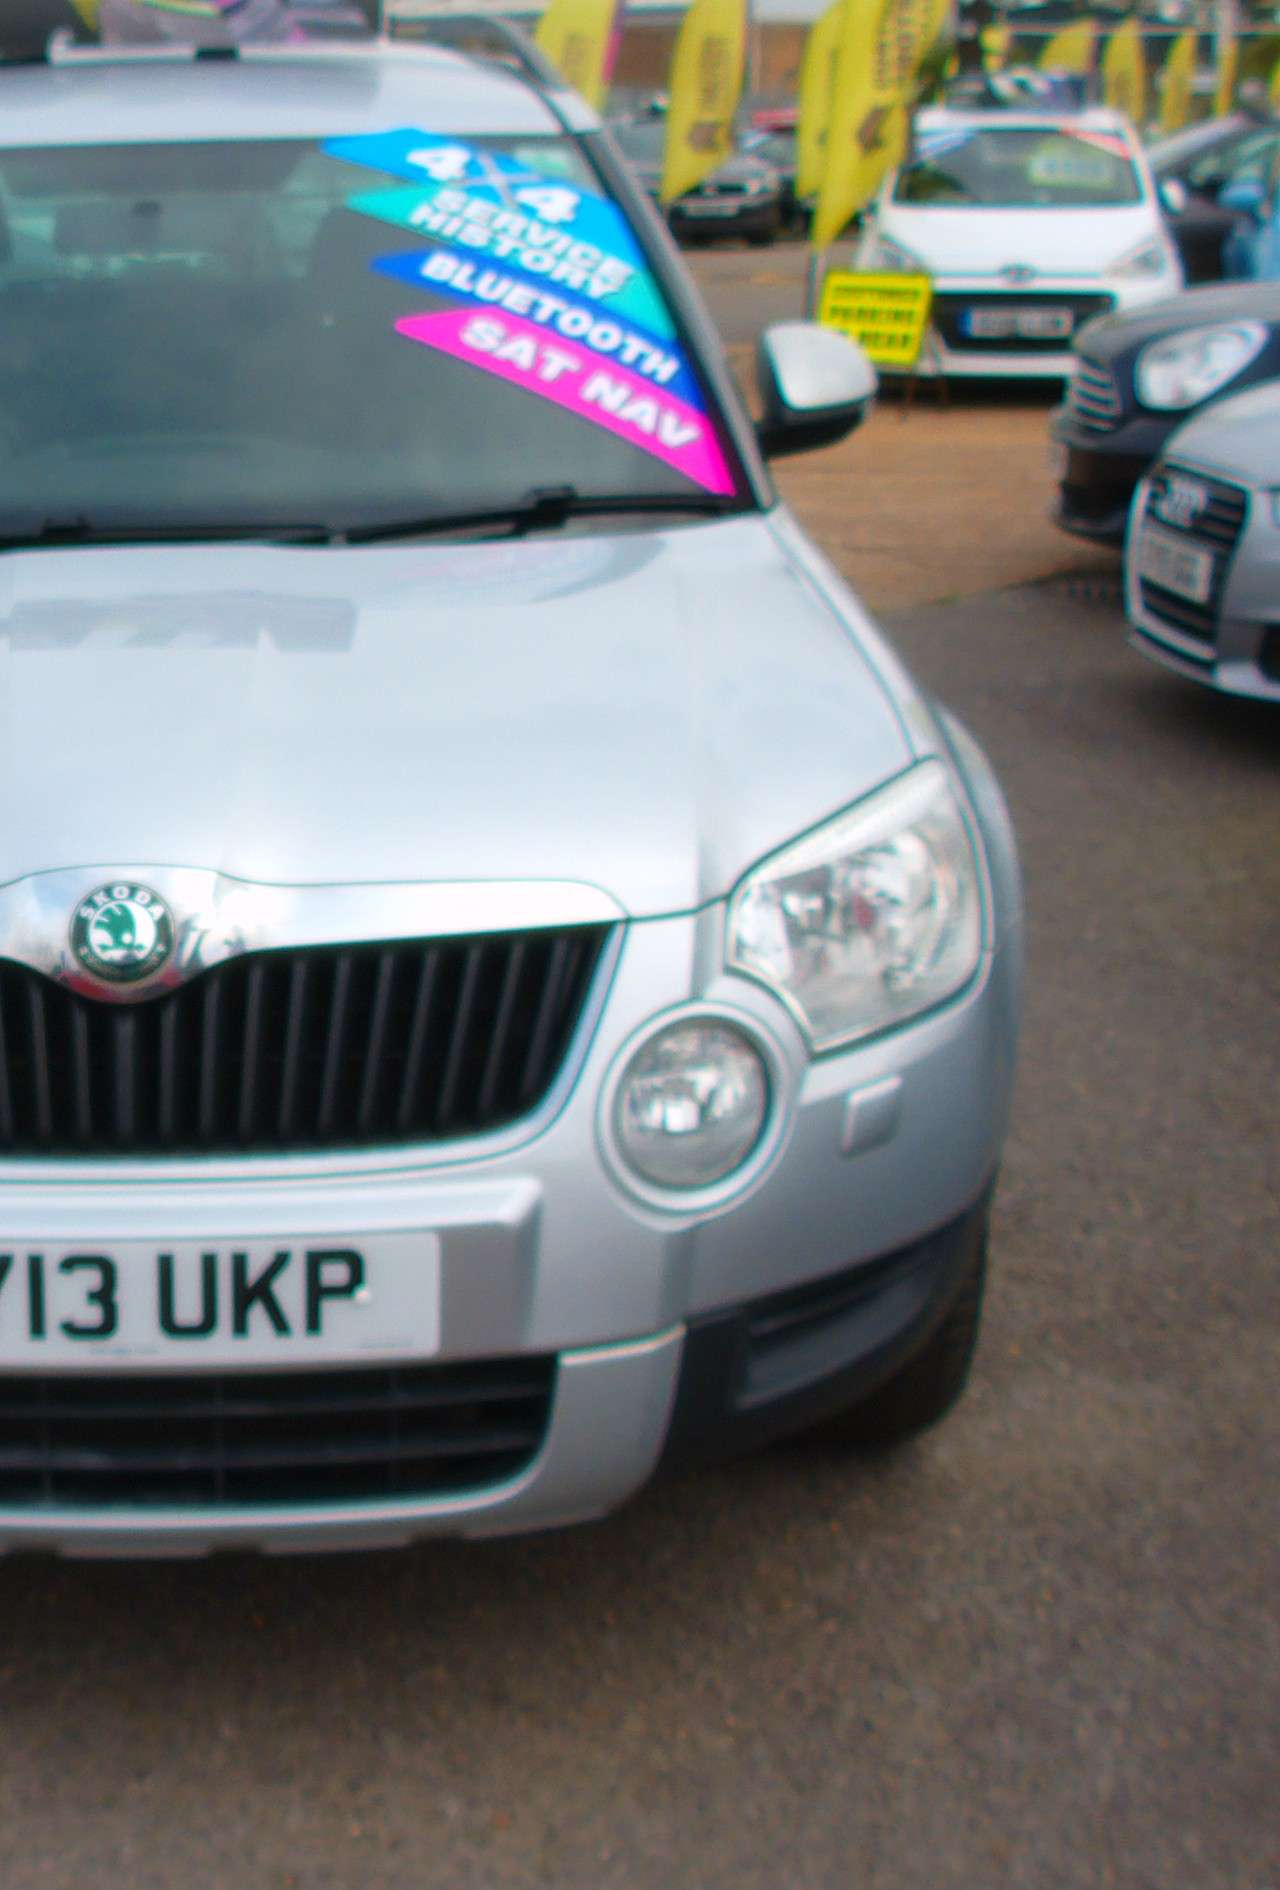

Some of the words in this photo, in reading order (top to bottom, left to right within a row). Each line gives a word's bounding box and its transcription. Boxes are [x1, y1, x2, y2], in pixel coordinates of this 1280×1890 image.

[410, 203, 626, 298] HISTORY
[432, 188, 633, 286] SERVICE
[421, 251, 680, 384] BLUETOOTH
[460, 315, 582, 383] SAT
[580, 373, 702, 449] NAV
[157, 1249, 369, 1339] UKP
